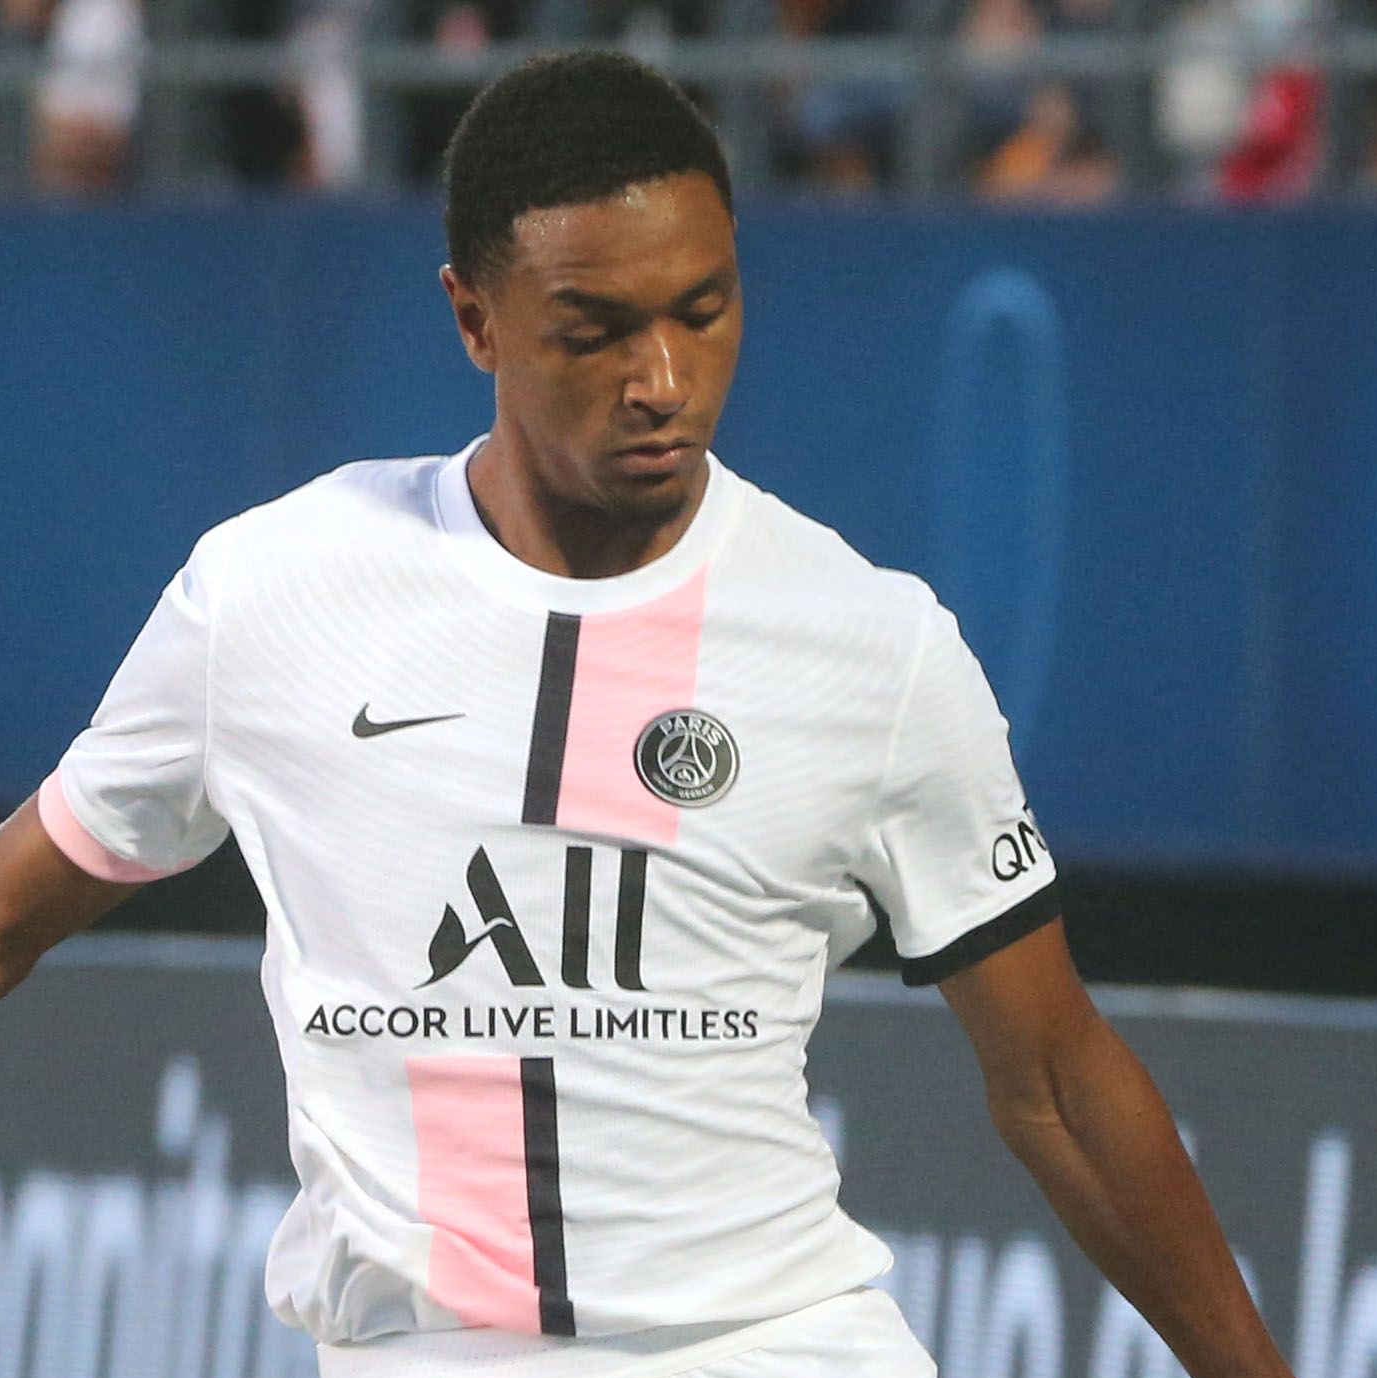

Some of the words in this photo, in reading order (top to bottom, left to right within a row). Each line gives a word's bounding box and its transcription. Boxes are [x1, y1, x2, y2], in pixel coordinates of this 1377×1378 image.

[659, 716, 723, 746] PARIS
[304, 1004, 448, 1038] ACCOR
[464, 1006, 554, 1038] LIVE
[570, 1007, 759, 1040] LIMITLESS
